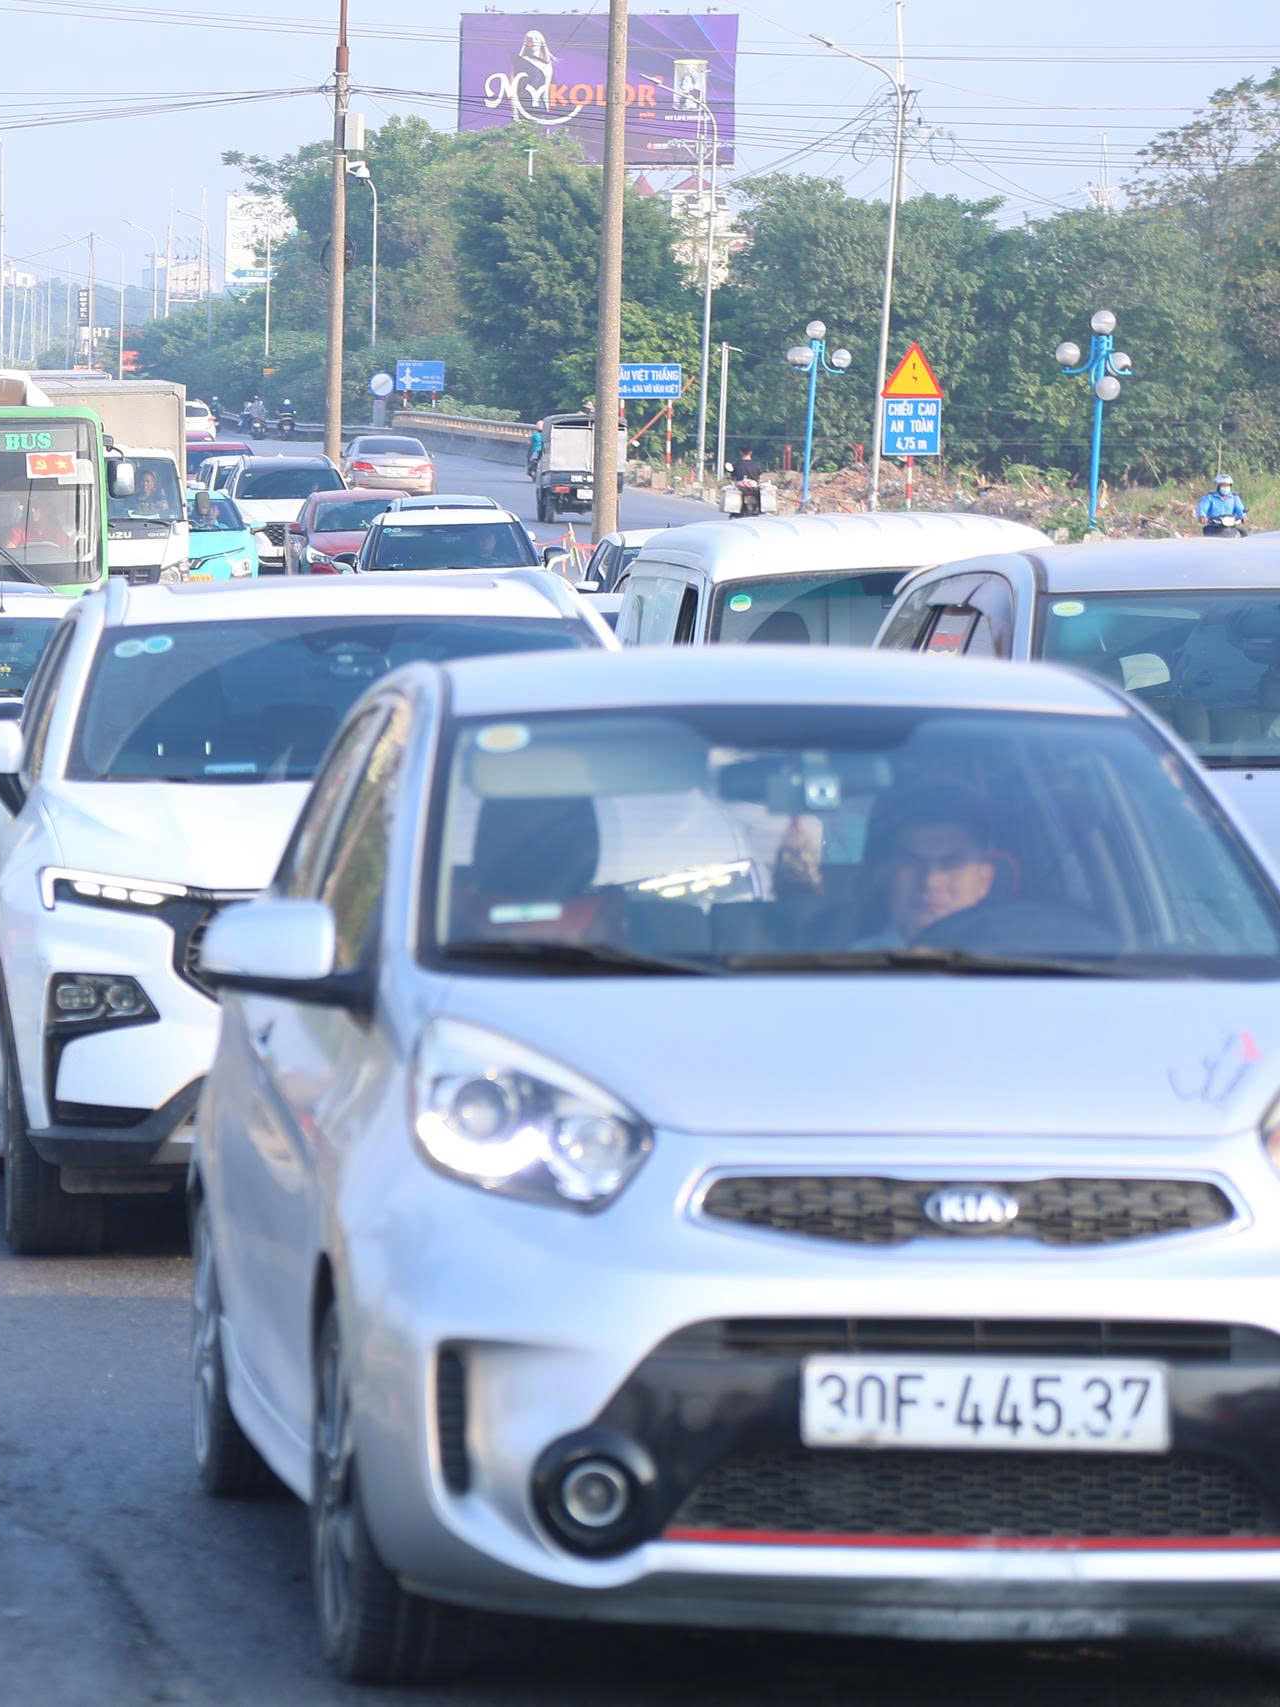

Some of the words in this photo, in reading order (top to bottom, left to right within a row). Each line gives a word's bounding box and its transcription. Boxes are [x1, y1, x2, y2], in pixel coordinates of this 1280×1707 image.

[619, 367, 631, 381] ẦU
[918, 403, 936, 416] CAO
[890, 420, 904, 433] AN
[910, 417, 934, 433] TOÀN
[5, 432, 52, 450] BUS
[896, 436, 915, 451] 4,75
[918, 440, 927, 450] m
[108, 531, 132, 539] UZU
[941, 1194, 1004, 1223] KIA
[818, 1373, 1151, 1438] 30F-445.37
